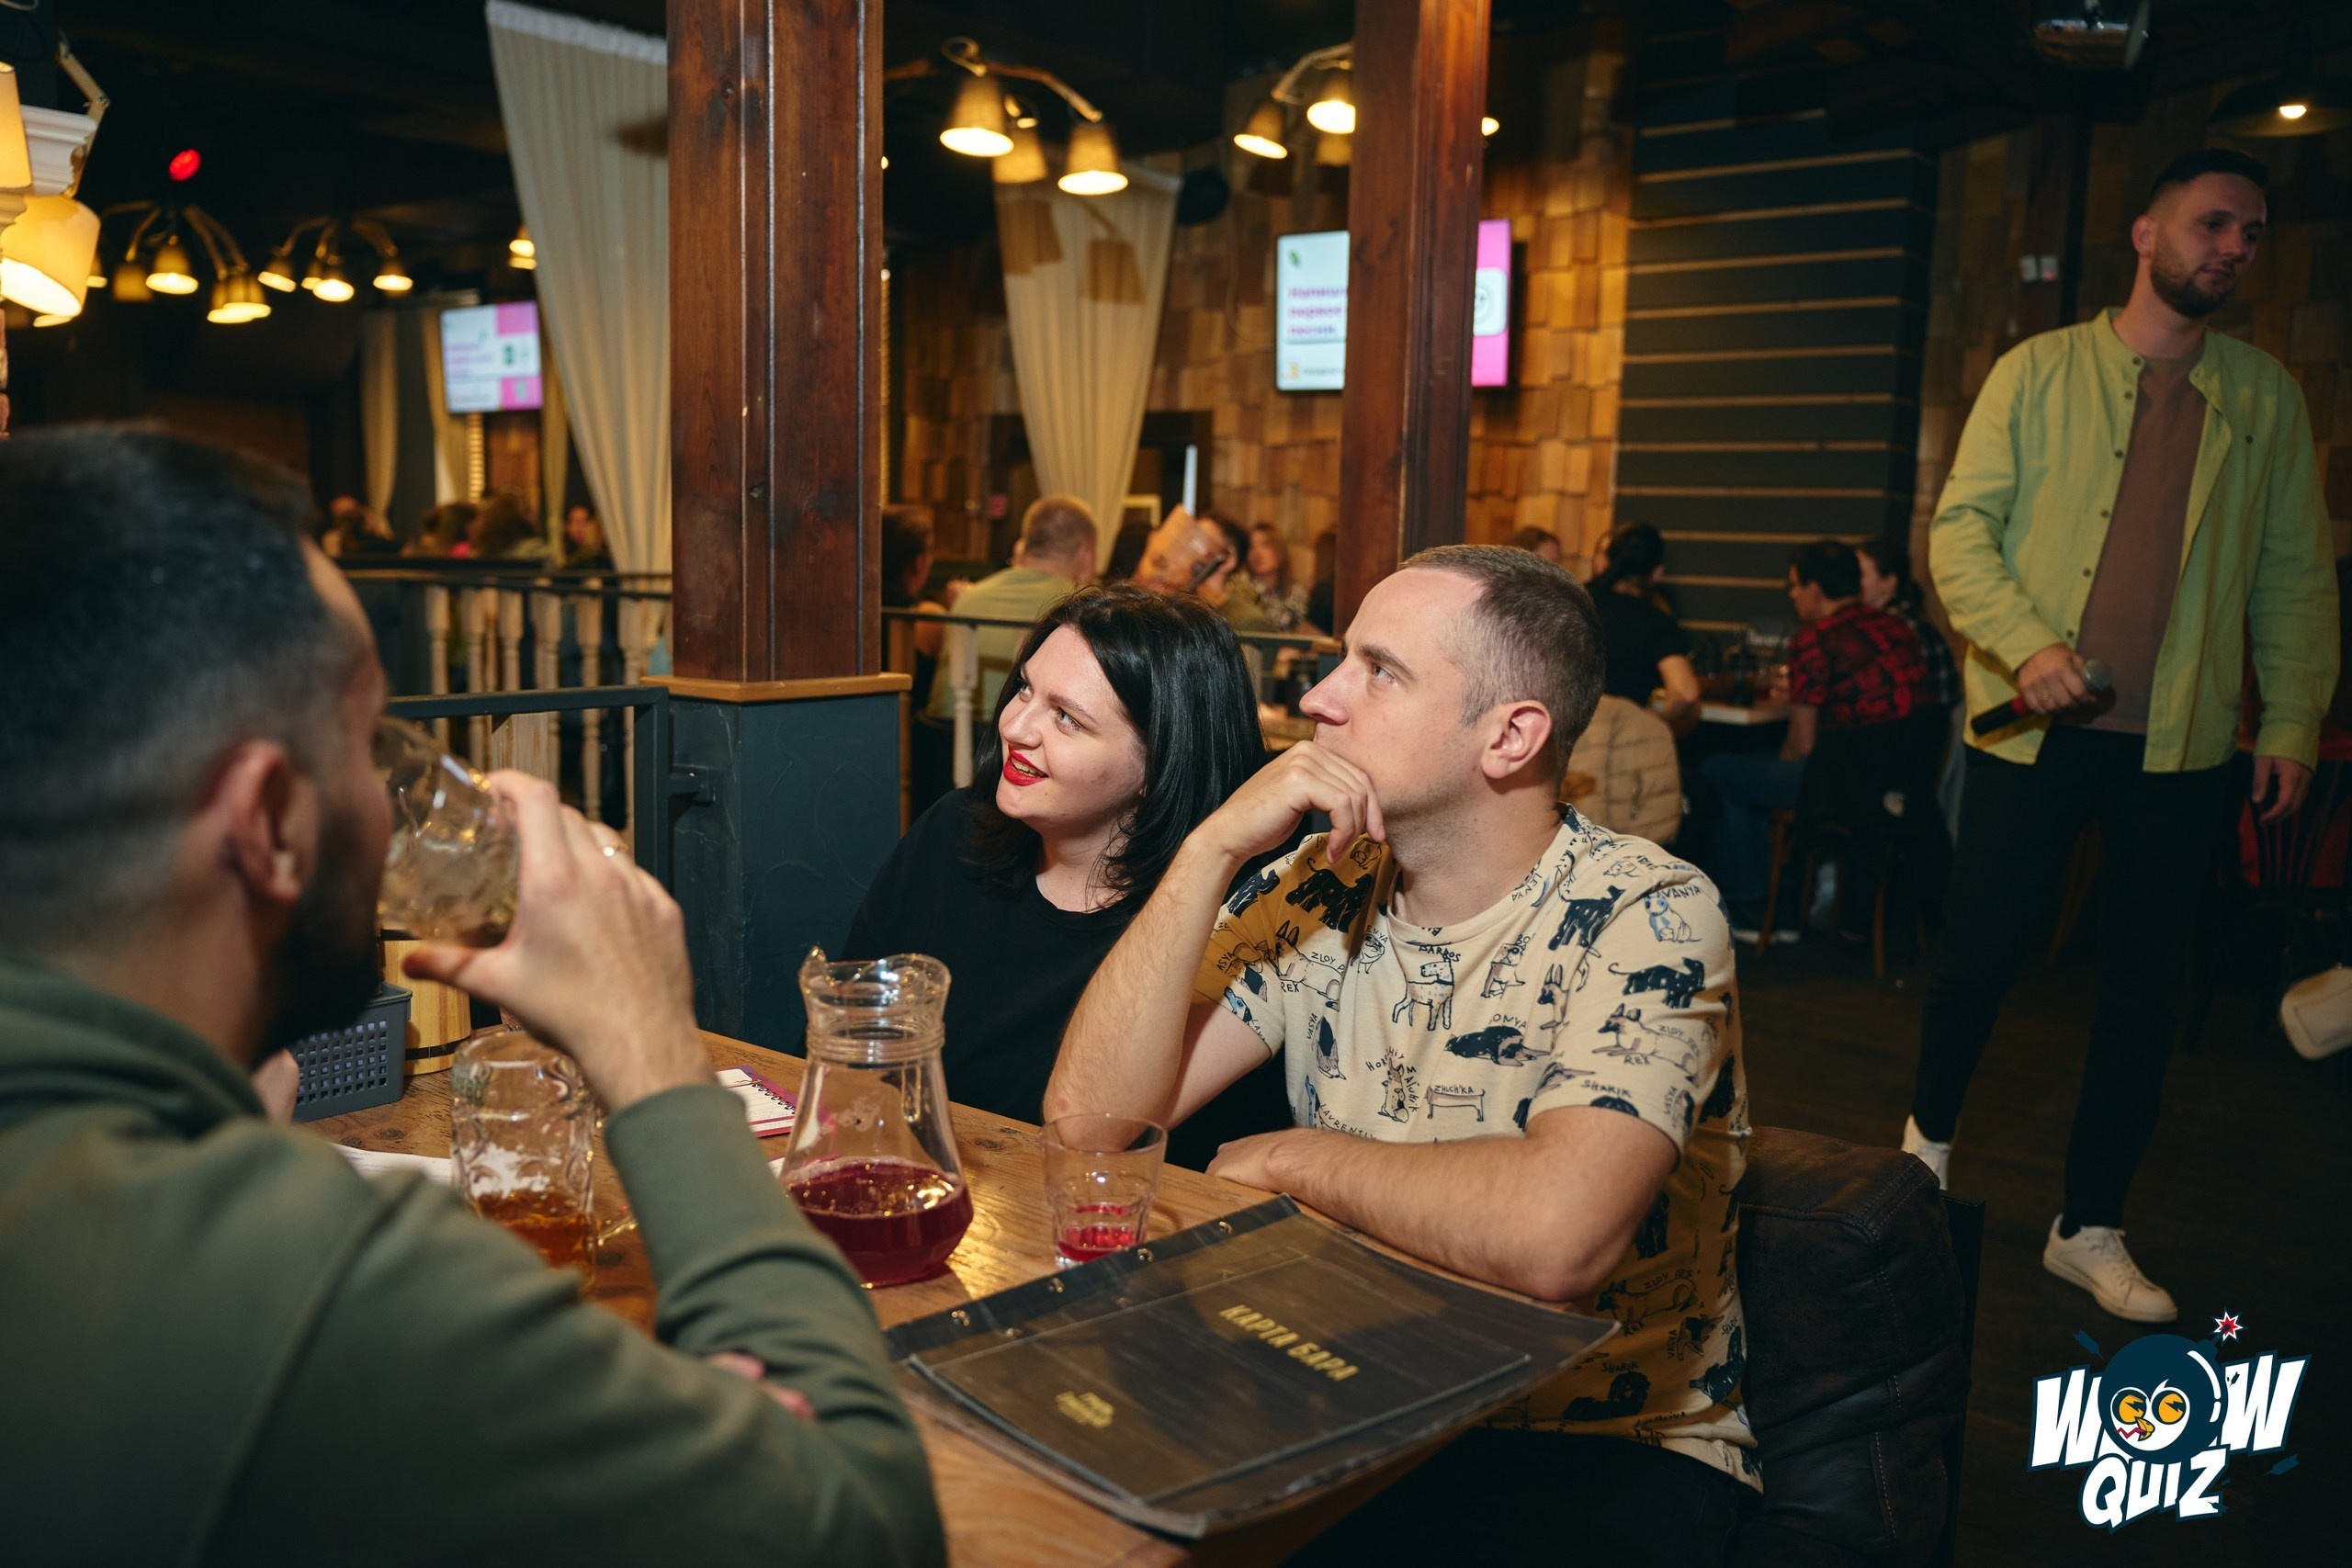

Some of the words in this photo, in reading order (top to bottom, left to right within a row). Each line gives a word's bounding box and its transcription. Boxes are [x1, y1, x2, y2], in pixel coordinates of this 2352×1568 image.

[1311, 951, 1336, 964] ZLOY
[1281, 981, 1300, 993] REX
[1306, 1012, 1318, 1040] VASYA
[1218, 1304, 1301, 1348] КАРТА
[1285, 1342, 1360, 1382] БАРА
